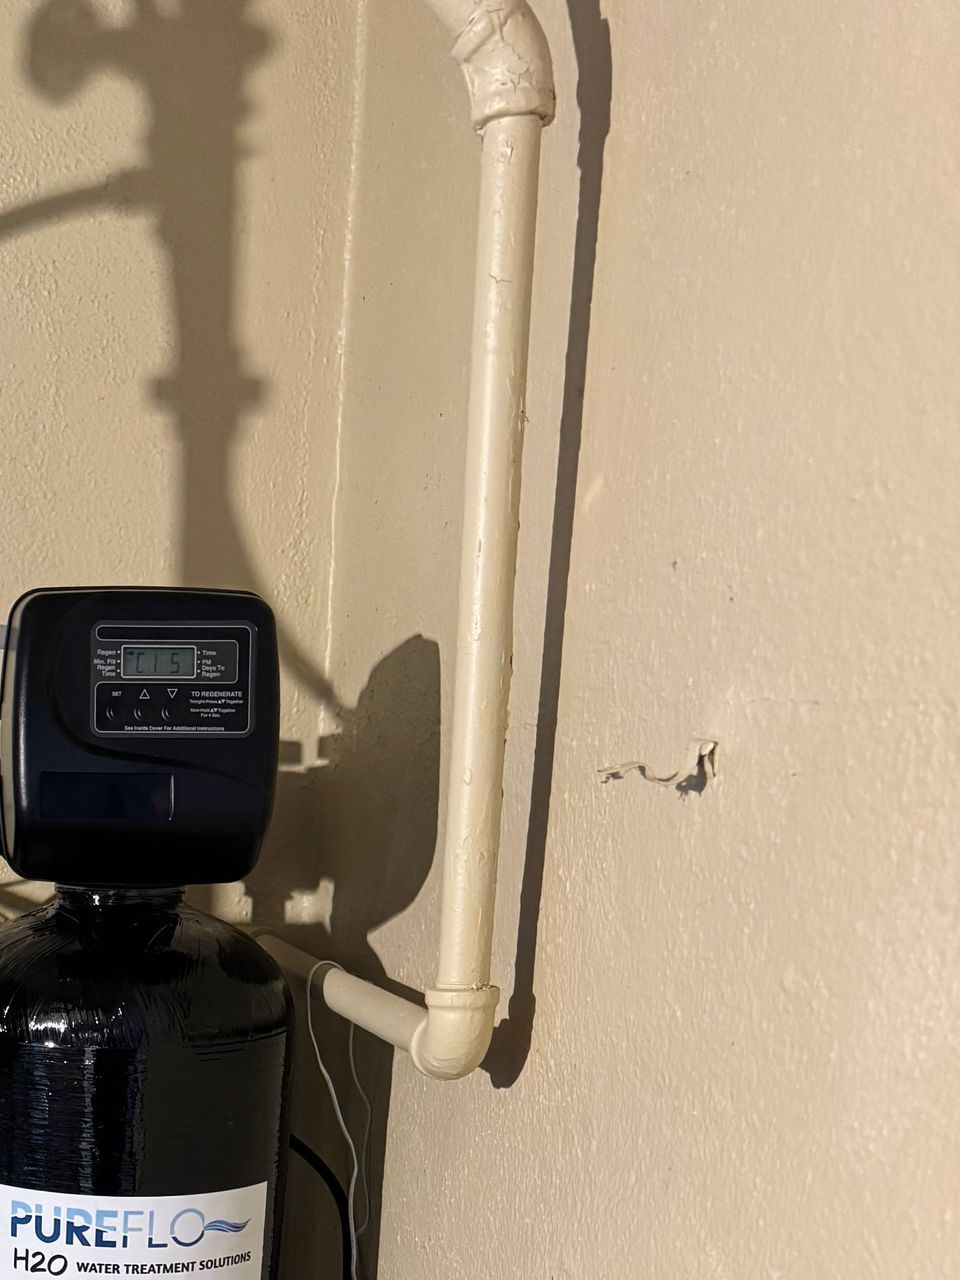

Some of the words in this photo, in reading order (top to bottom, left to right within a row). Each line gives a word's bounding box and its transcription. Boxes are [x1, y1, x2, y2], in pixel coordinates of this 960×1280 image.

[10, 1200, 205, 1248] PUREFLO
[13, 1248, 68, 1276] H2O
[77, 1262, 120, 1274] WATER
[124, 1261, 196, 1275] TREATMENT
[199, 1251, 251, 1271] SOLUTIONS
